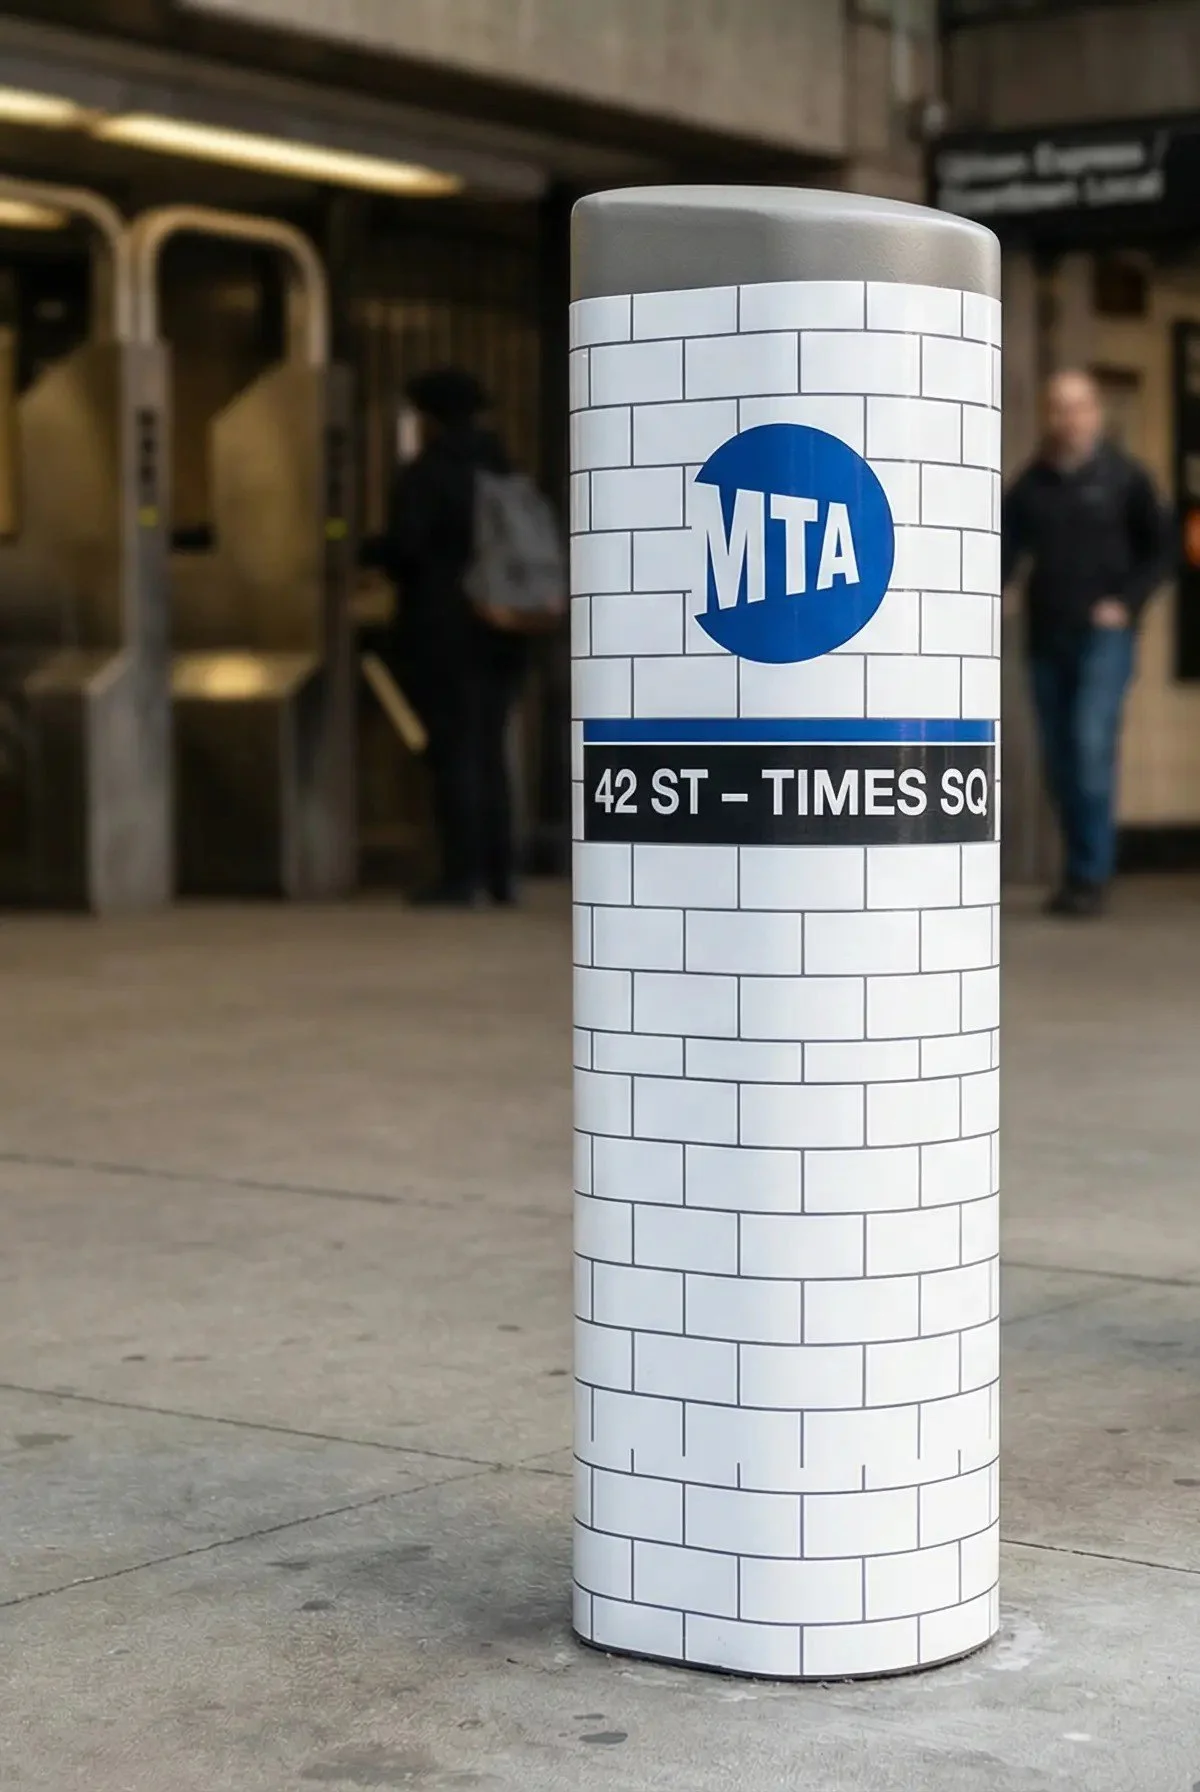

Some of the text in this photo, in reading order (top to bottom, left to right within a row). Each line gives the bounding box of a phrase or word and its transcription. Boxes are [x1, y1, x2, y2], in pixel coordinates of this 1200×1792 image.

[693, 482, 860, 616] MTA
[594, 768, 638, 814] 42
[650, 767, 709, 815] ST
[761, 768, 928, 816] TIMES
[939, 768, 989, 817] SQ
